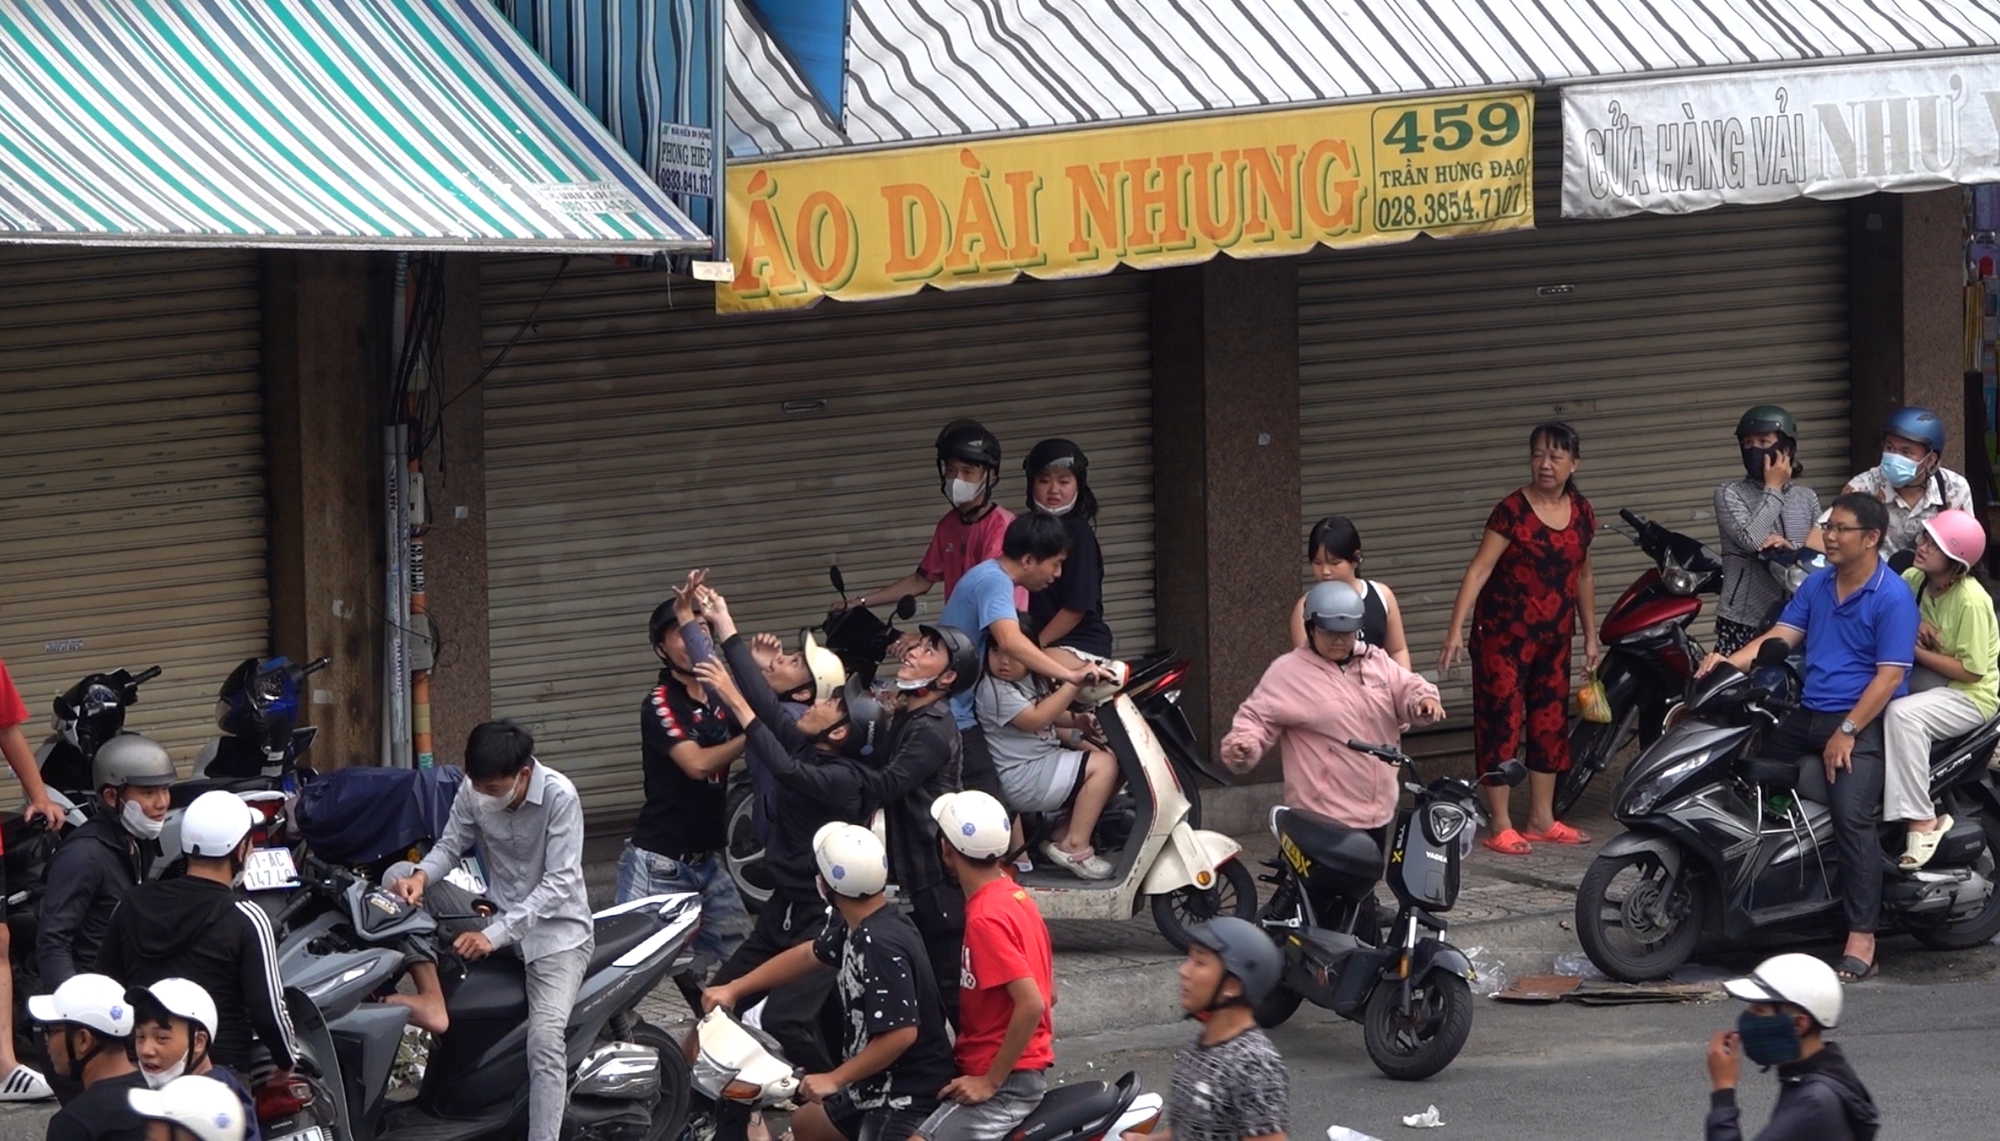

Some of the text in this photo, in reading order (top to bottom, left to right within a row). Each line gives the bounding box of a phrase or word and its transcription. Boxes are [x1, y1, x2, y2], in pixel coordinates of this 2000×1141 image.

[1382, 102, 1520, 154] 459
[1585, 100, 1650, 199] CỬA
[1656, 102, 1745, 193] HÀNG
[1751, 86, 1806, 186] VẢI
[1812, 73, 1964, 181] NHƯ
[661, 142, 689, 166] PHONG
[1380, 158, 1525, 188] TRẦN HƯNG ĐẠO
[731, 138, 1367, 298] ÁO DÀI NHUNG
[1378, 183, 1522, 228] 028.3854.7107
[1425, 850, 1448, 864] YADEA
